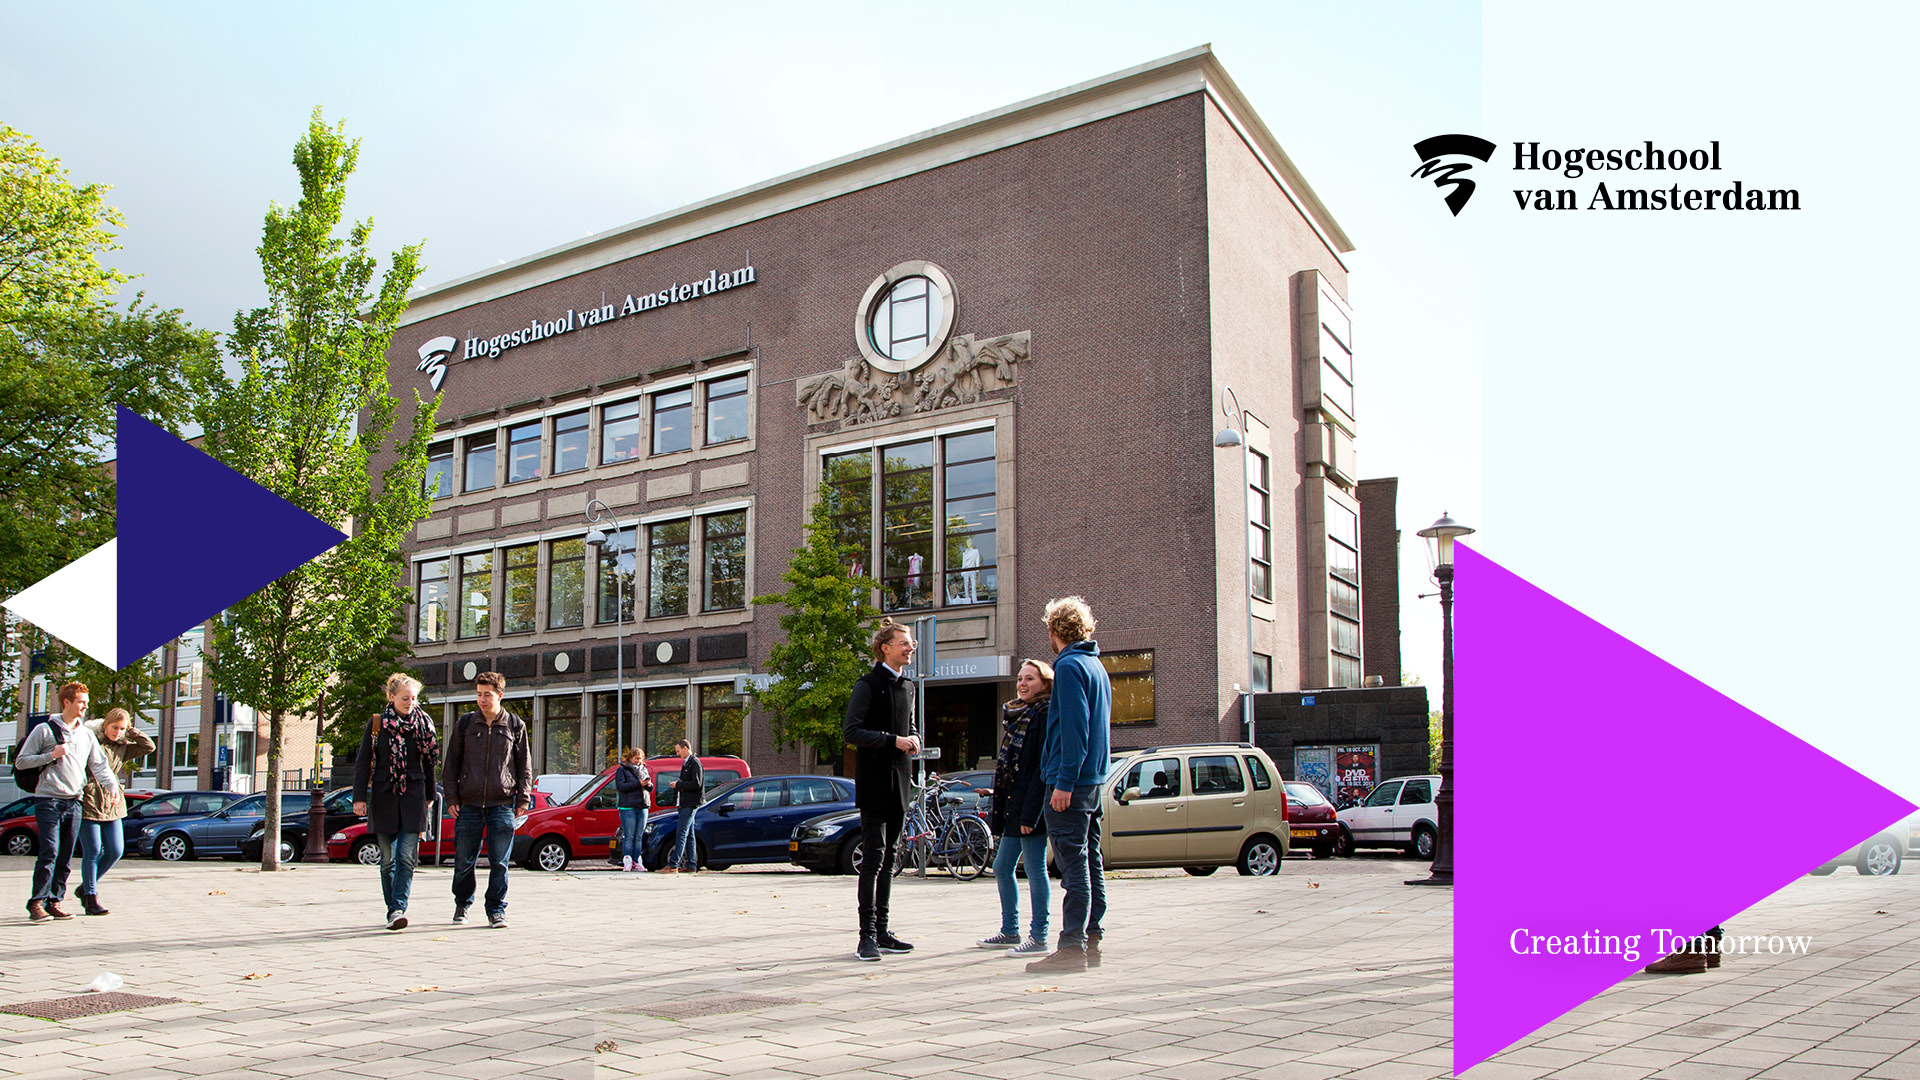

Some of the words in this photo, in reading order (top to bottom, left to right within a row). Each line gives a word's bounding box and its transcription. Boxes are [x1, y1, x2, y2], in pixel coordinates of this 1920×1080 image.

[463, 309, 575, 360] Hogeschool
[578, 303, 616, 328] van
[620, 265, 757, 317] Amsterdam
[934, 663, 977, 676] stitute
